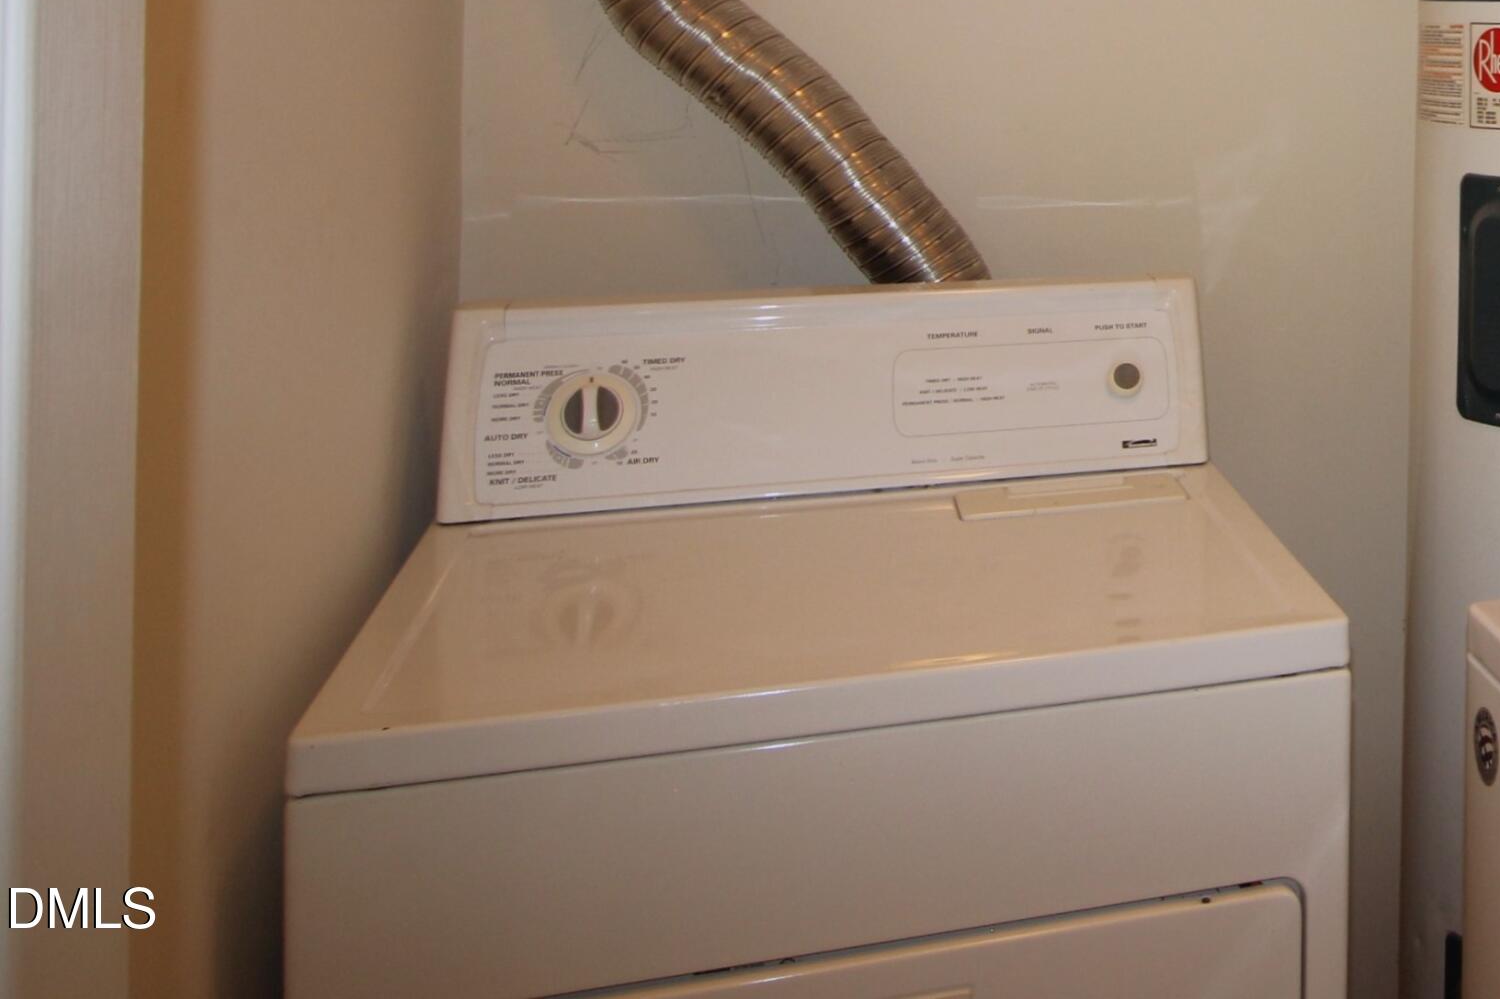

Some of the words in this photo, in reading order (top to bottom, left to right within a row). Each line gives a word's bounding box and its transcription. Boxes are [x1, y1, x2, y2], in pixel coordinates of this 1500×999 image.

[927, 331, 978, 340] TEMPERATURE
[494, 371, 539, 380] PERMANENT
[494, 379, 530, 387] NORMAL
[484, 433, 510, 441] AUTO
[511, 432, 528, 440] DRY
[642, 456, 660, 464] DRY
[517, 474, 557, 484] DELICATE
